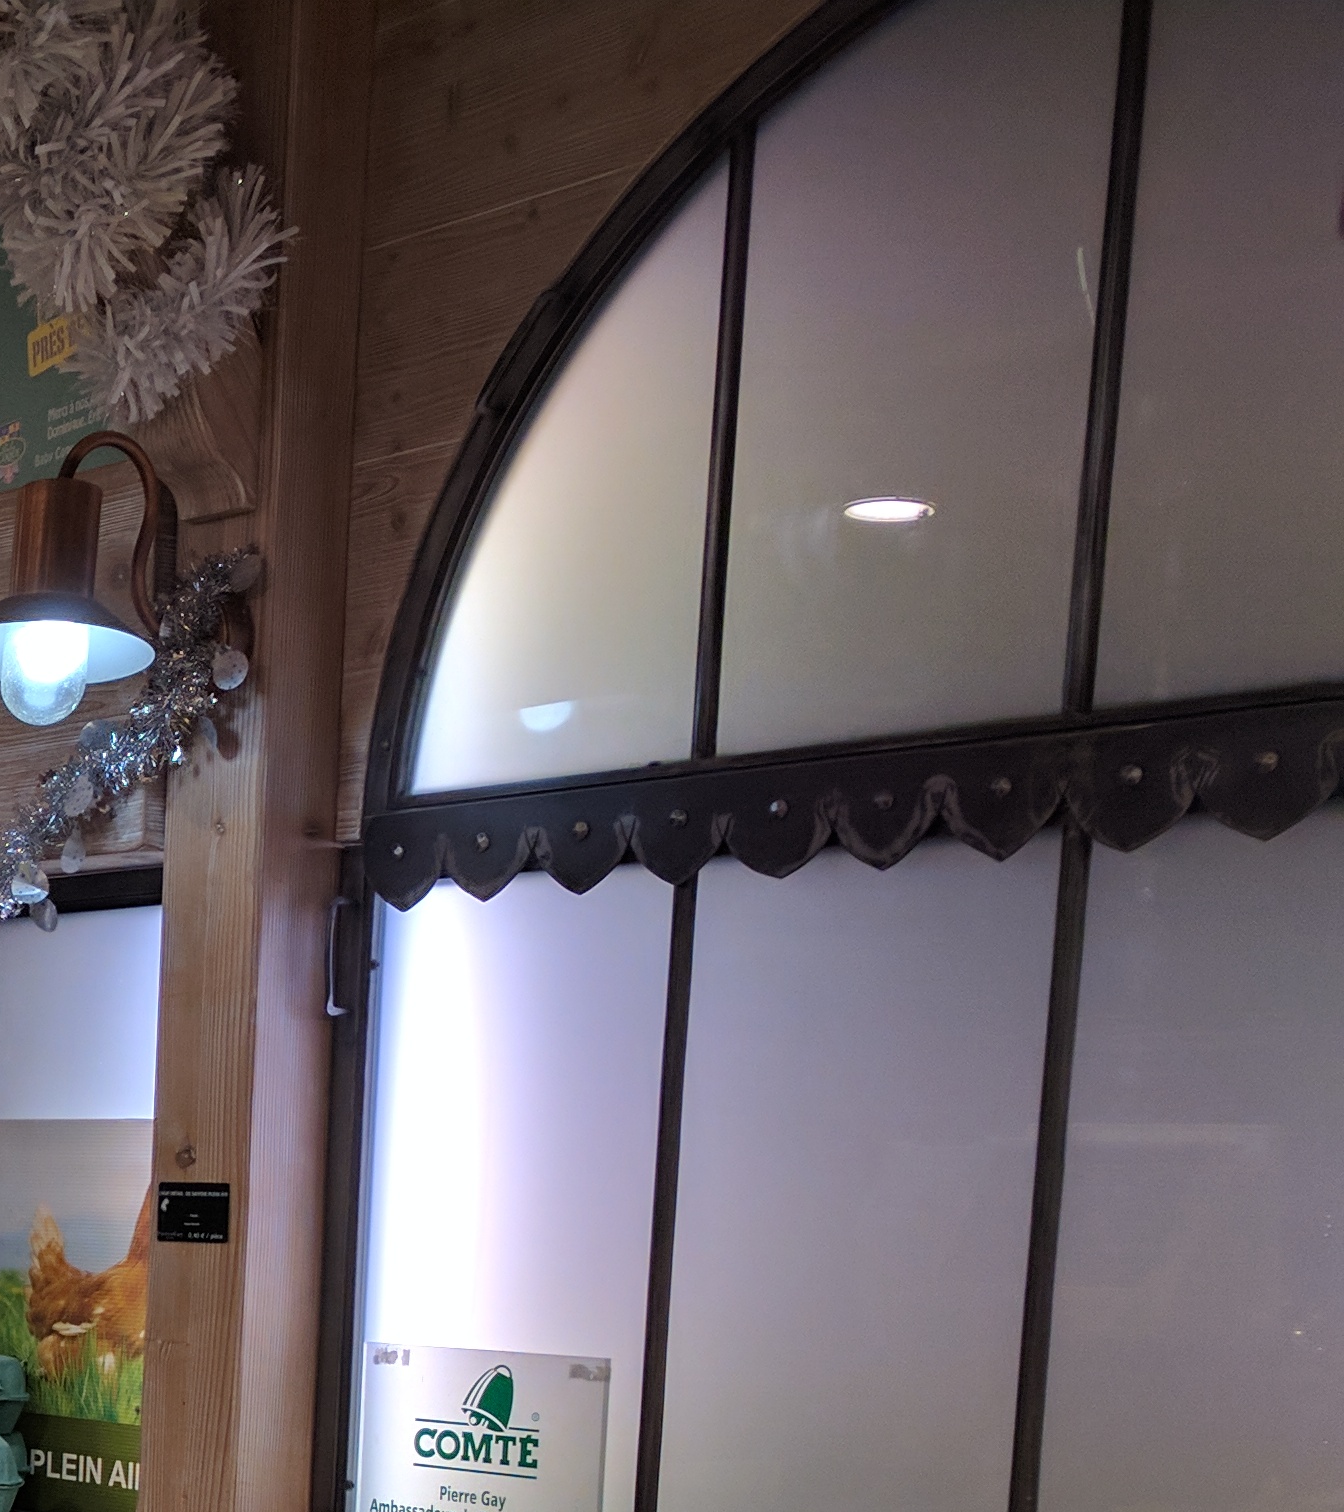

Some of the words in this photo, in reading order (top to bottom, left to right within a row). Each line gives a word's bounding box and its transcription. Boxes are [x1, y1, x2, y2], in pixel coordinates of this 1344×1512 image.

[32, 324, 64, 368] PRÈS
[29, 1448, 103, 1487] PLEIN
[414, 1427, 539, 1469] COMTÉ
[440, 1485, 477, 1504] Pierre
[481, 1491, 506, 1511] Gay
